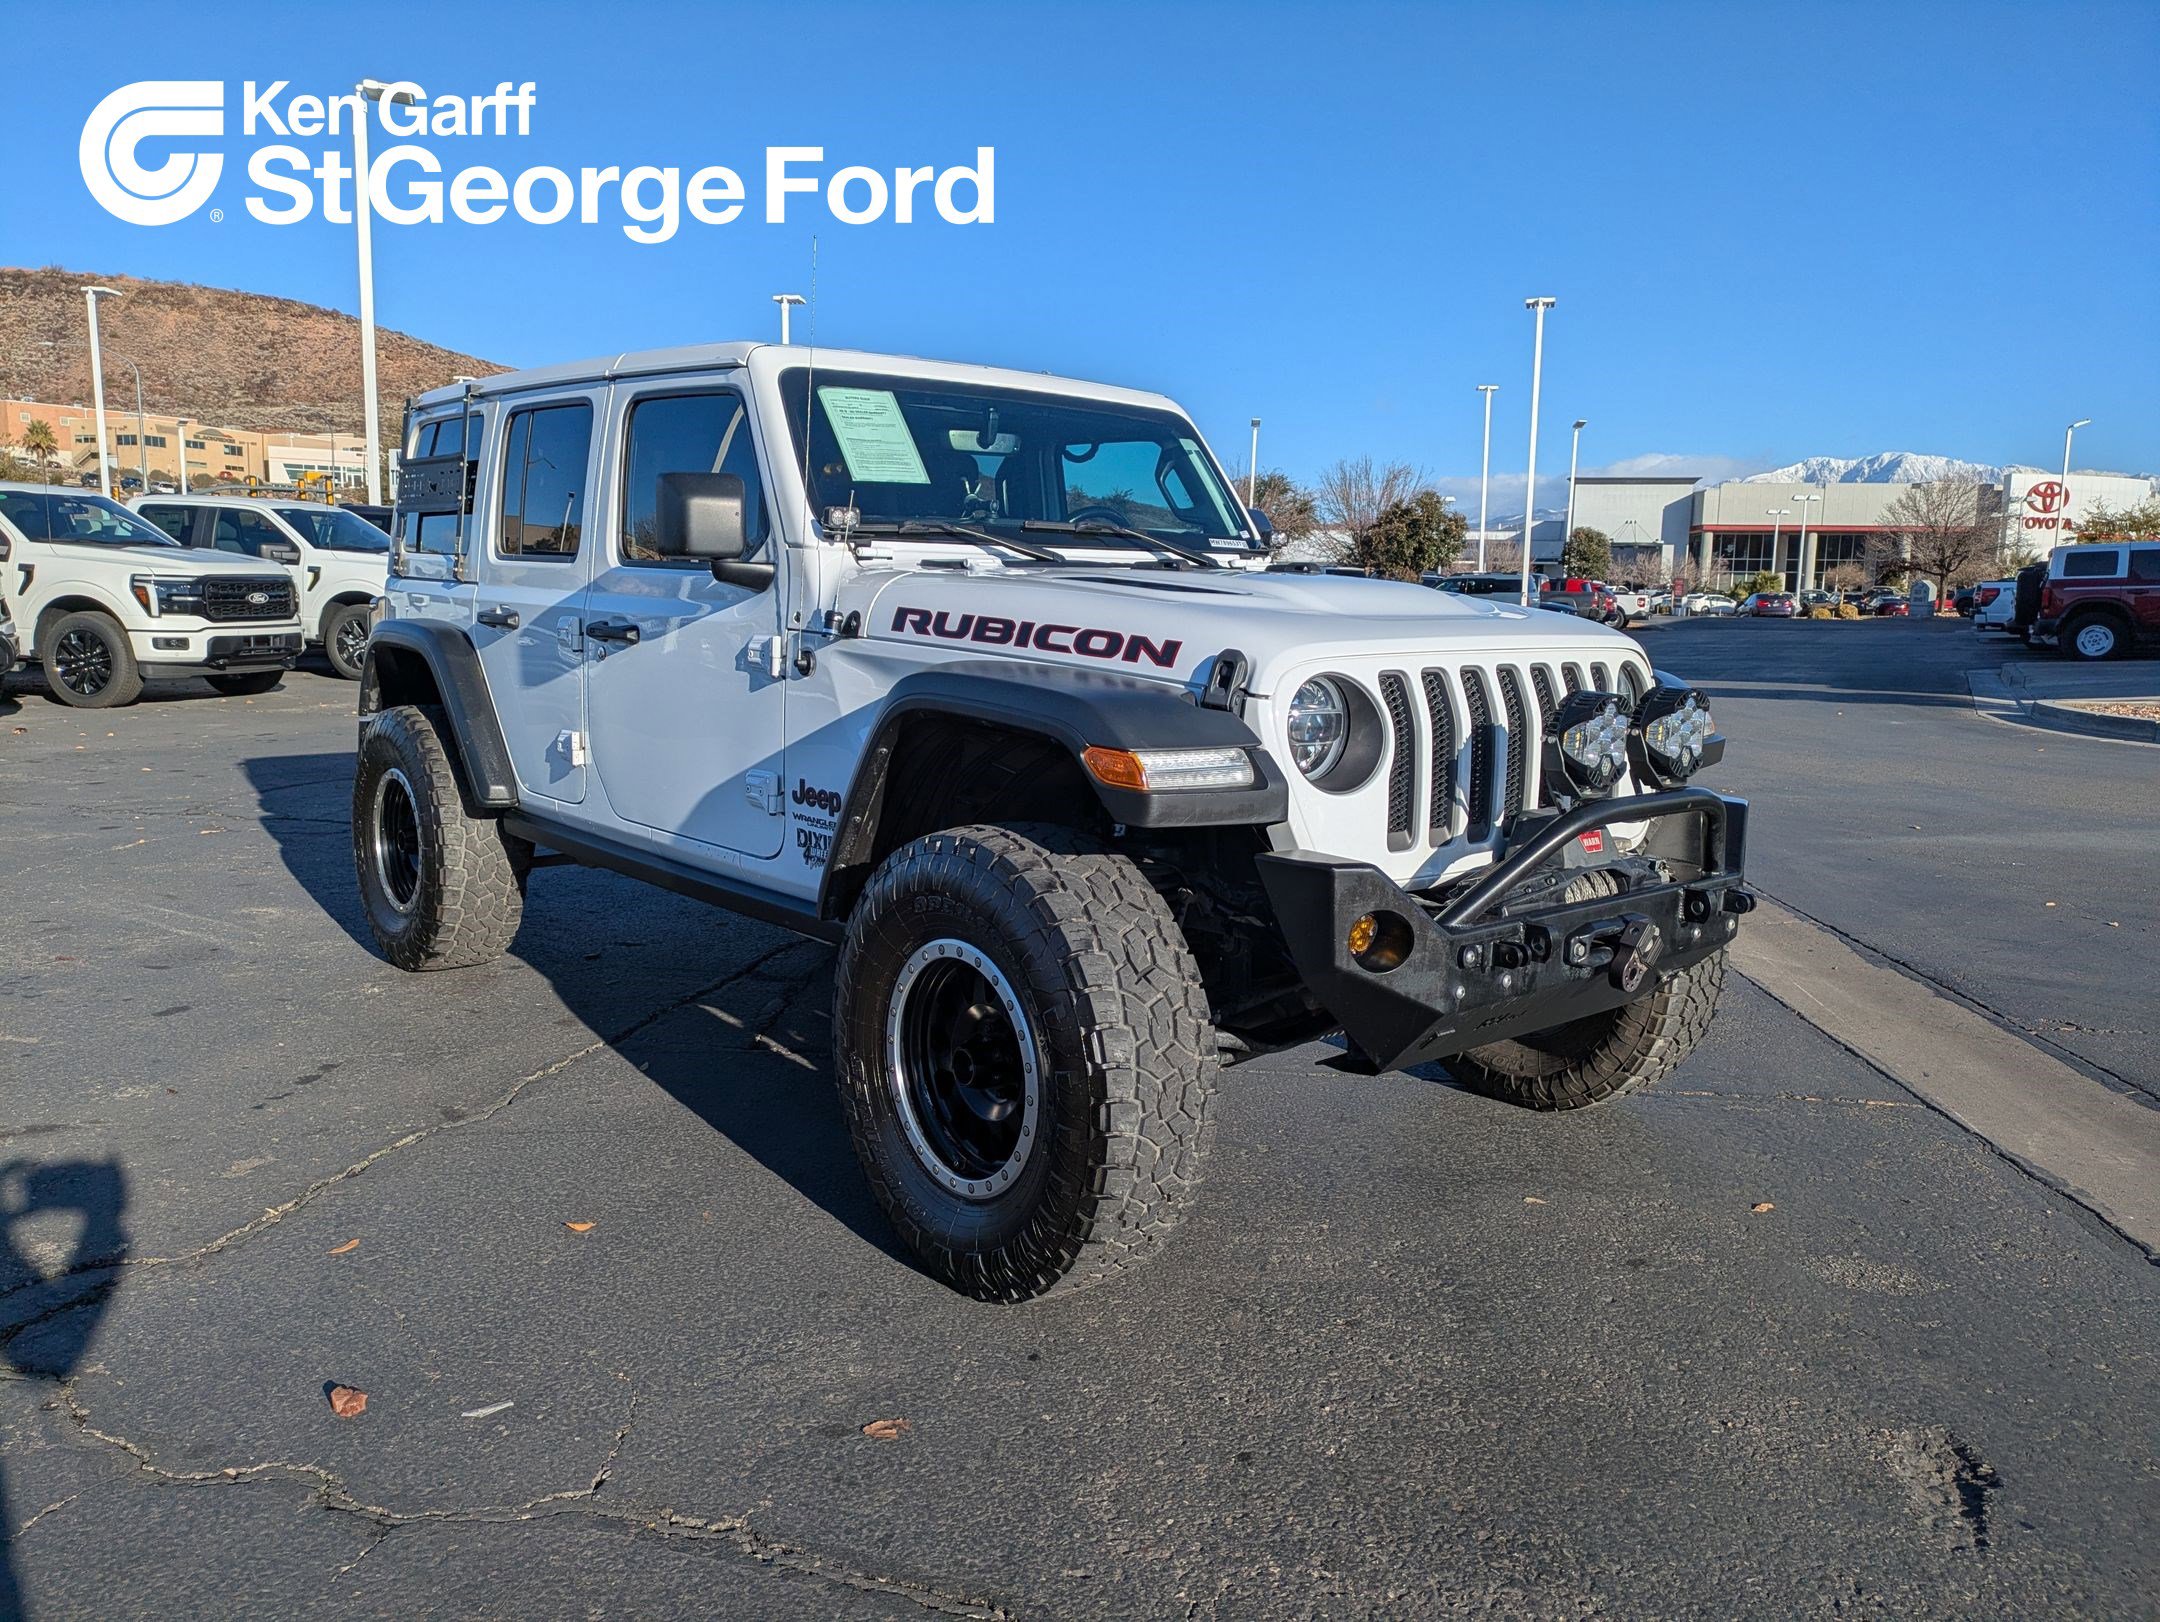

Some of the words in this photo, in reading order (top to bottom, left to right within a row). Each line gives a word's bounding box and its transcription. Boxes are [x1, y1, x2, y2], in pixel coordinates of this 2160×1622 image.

[2016, 516, 2073, 530] TOYOA
[890, 606, 1183, 668] RUBICON
[791, 778, 842, 817] Jeep
[1582, 836, 1601, 847] WARN
